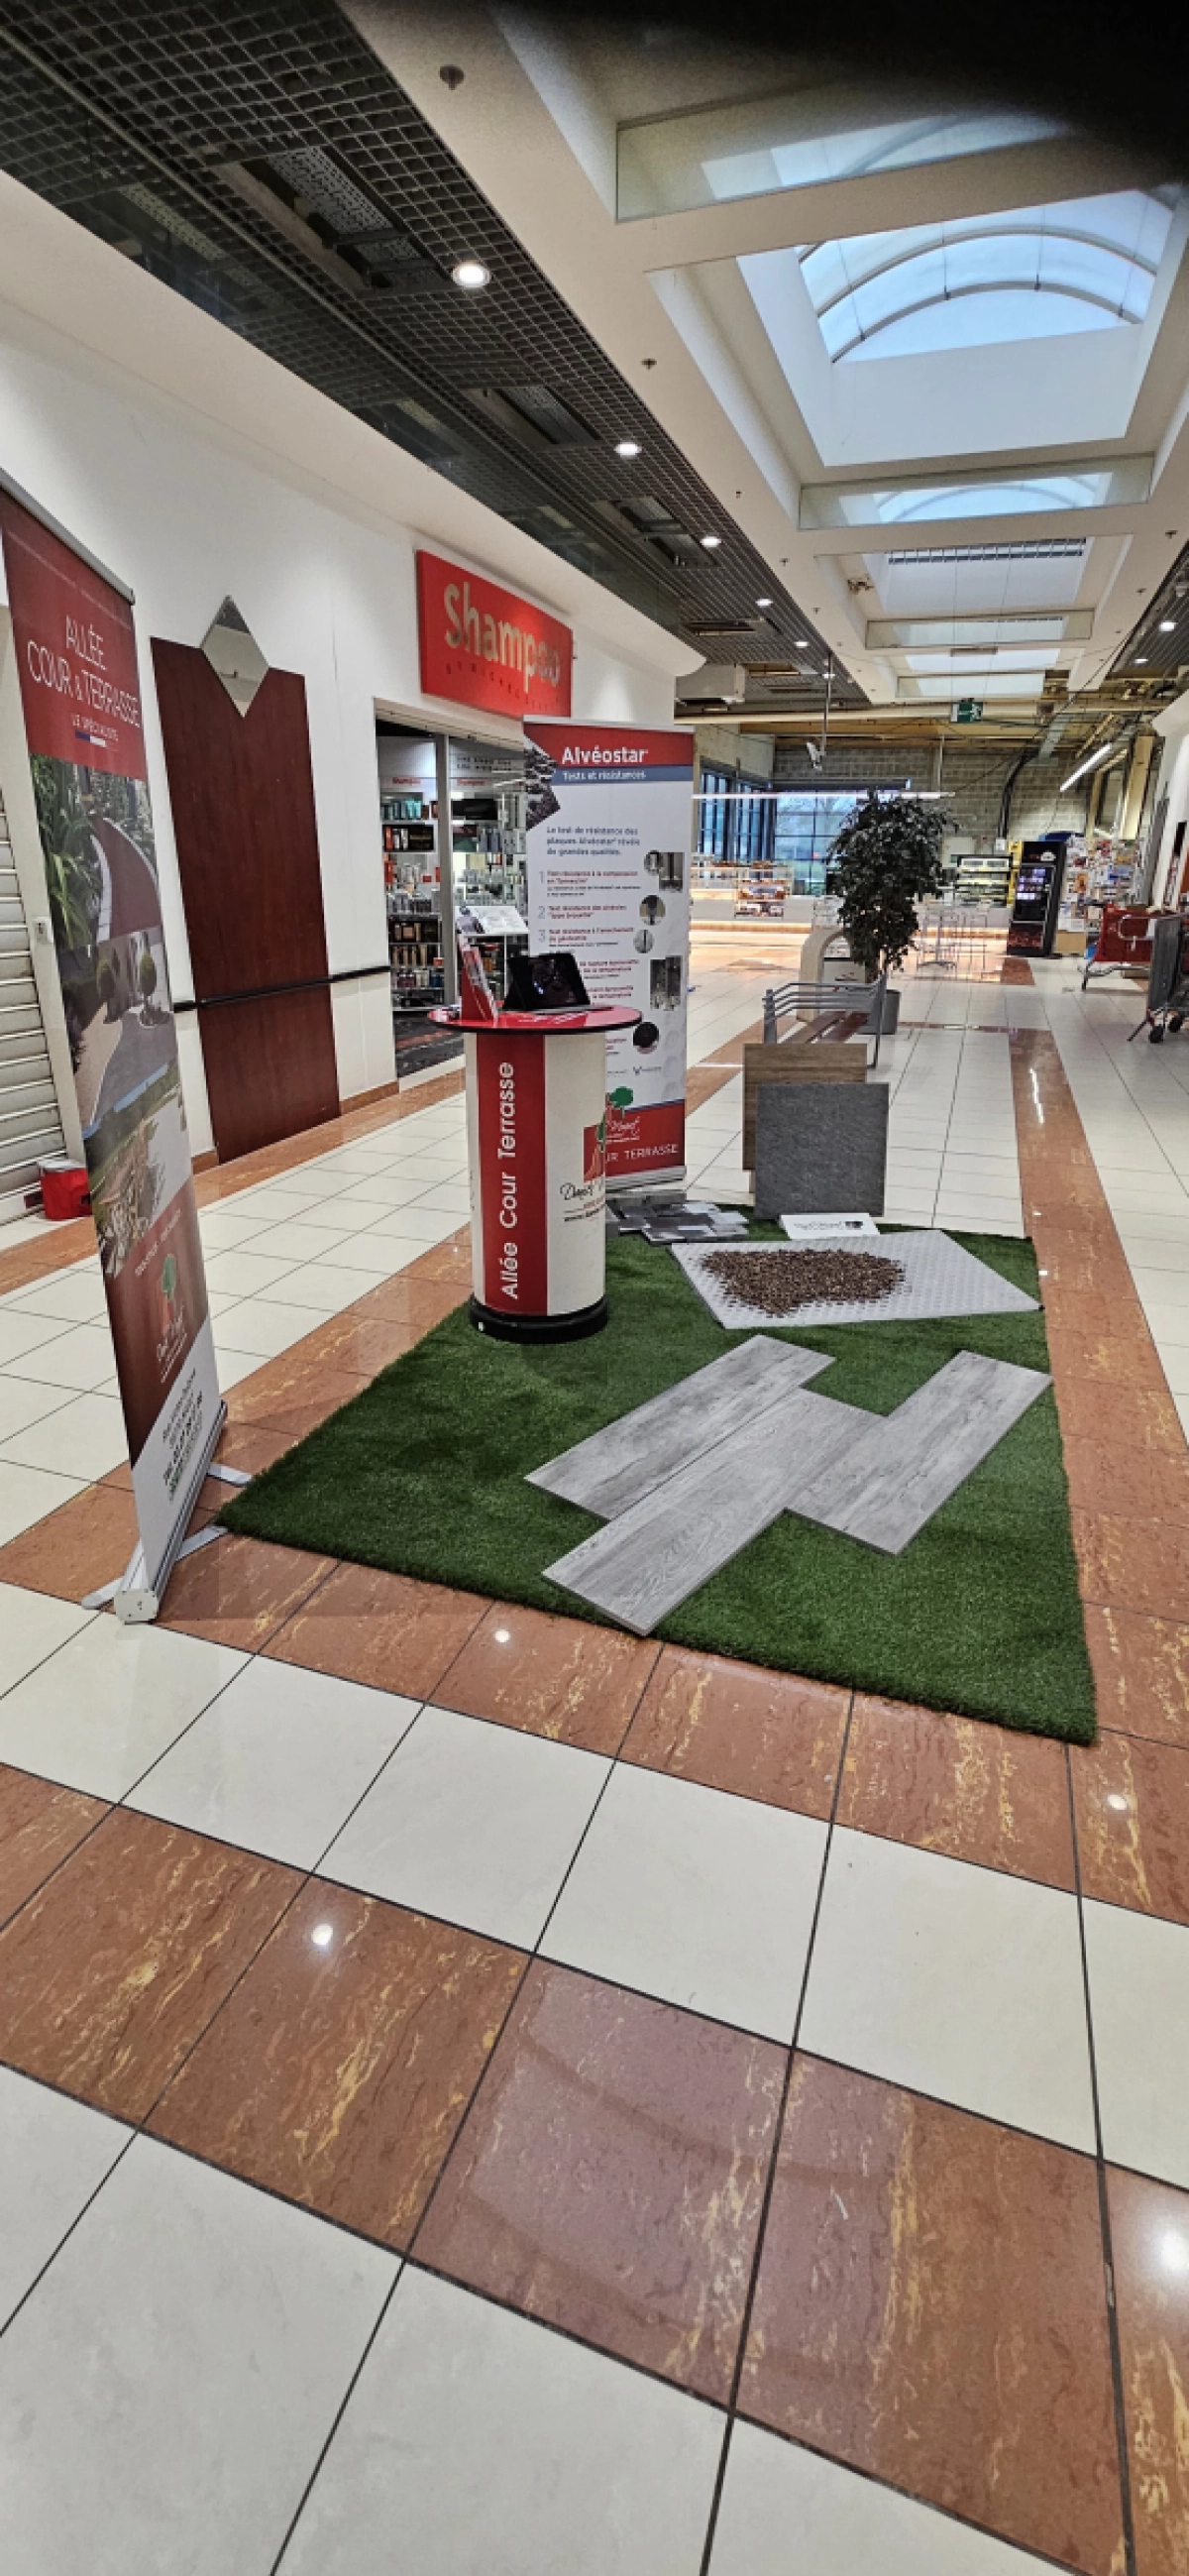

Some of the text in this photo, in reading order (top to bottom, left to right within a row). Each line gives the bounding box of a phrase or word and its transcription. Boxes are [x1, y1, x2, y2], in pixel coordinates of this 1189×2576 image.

[65, 615, 107, 671] ALLÉE
[444, 581, 561, 694] Shampoo
[27, 639, 73, 698] COUR
[81, 669, 140, 728] TERRASSE
[497, 1062, 519, 1300] Allée Cour Terrasse
[624, 1144, 680, 1161] TERRASSE
